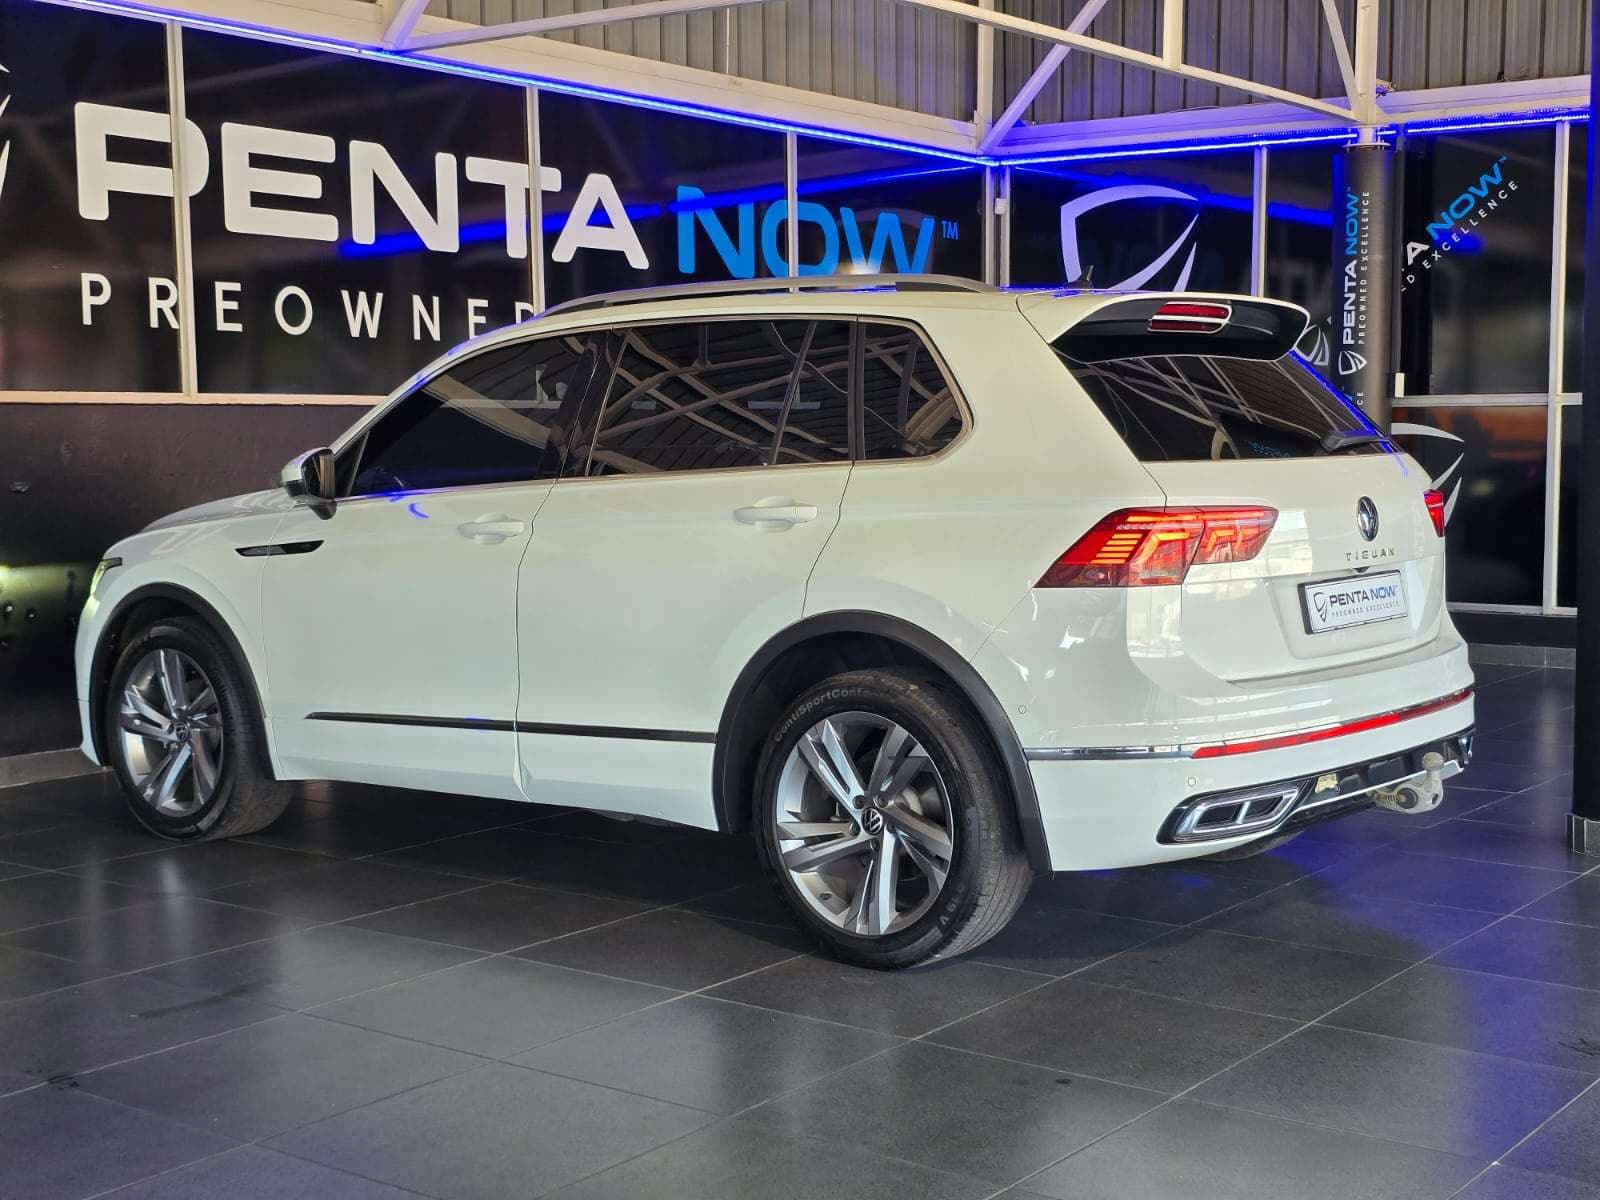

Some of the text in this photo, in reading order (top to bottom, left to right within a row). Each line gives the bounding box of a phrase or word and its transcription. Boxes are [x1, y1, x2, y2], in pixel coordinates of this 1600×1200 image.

[74, 101, 650, 270] PENTA
[676, 185, 935, 279] NOW
[1421, 179, 1519, 270] EXCELLENCE
[1425, 162, 1503, 241] NOW
[1342, 192, 1360, 346] PENTA NOW
[1357, 191, 1371, 345] PREOWNED EXCELLENCE
[1329, 585, 1396, 607] PENTA NOW
